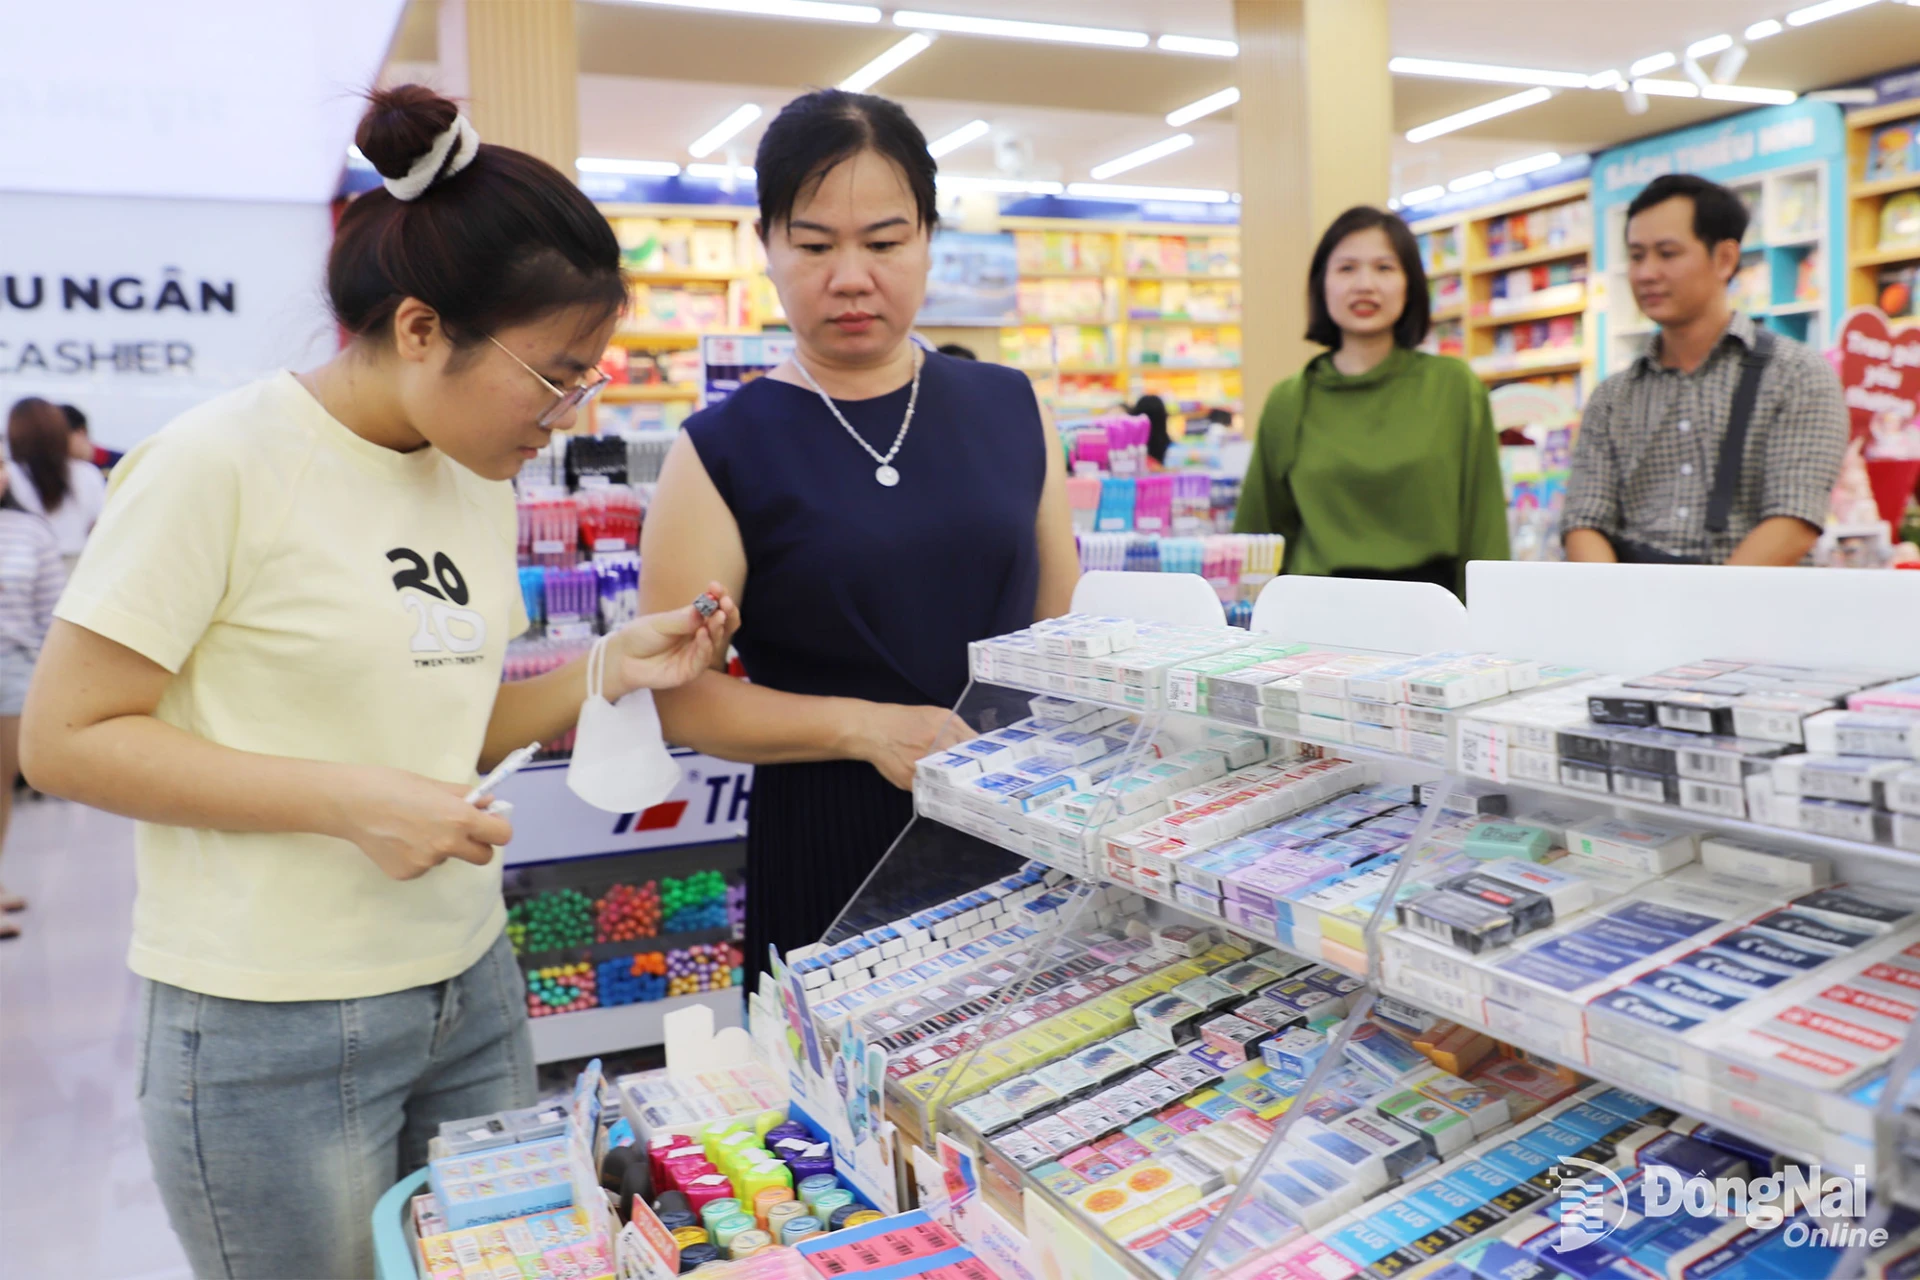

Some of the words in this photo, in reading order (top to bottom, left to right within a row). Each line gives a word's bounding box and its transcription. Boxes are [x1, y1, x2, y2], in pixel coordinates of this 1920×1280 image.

[0, 275, 44, 310] U
[61, 266, 236, 313] NGÂN
[385, 547, 469, 606] 20
[1572, 1104, 1616, 1125] PLUS
[1537, 1124, 1582, 1147] PLUS
[1501, 1143, 1546, 1166] PLUS
[1464, 1163, 1508, 1186] PLUS
[1427, 1183, 1471, 1207] PLUS
[1387, 1202, 1431, 1228] PLUS
[1347, 1223, 1389, 1250] PLUS
